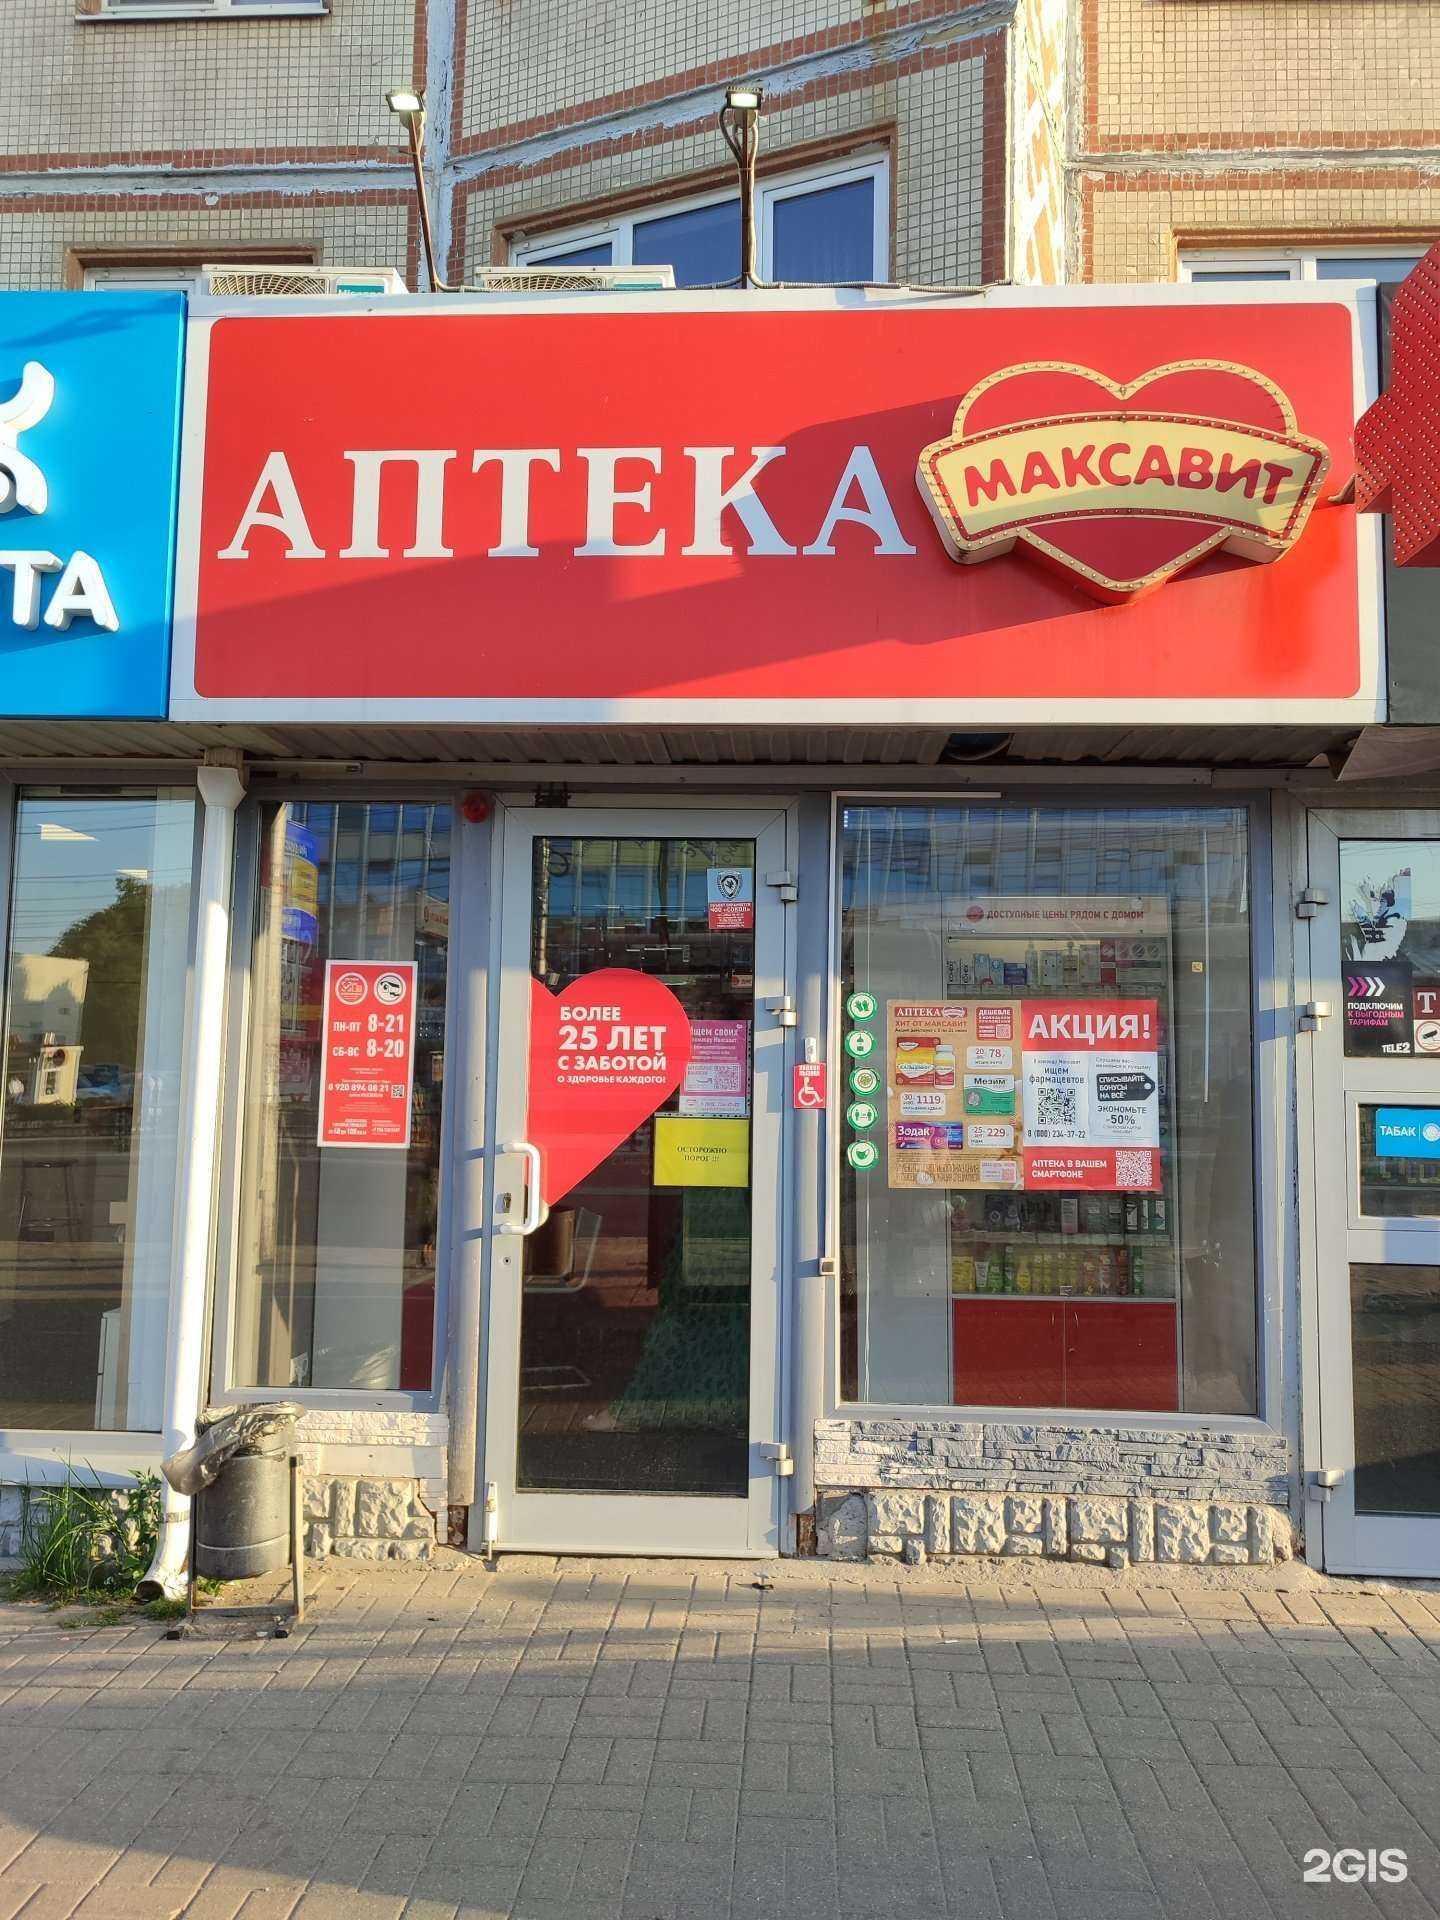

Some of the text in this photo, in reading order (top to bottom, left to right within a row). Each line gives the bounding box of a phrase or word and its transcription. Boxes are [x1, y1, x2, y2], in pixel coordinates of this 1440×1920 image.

[963, 442, 1294, 507] МАКСАВИТ
[217, 445, 917, 560] АПТЕКА
[987, 910, 1144, 920] ДОСТУПНЫЕ ЦЕНЫ РЯДОМ С ДОМОМ
[1347, 1002, 1404, 1011] ПОДКЛЮЧИМ
[560, 1006, 621, 1021] БОЛЕЕ
[897, 1007, 941, 1017] АПТЕКА
[1355, 1010, 1404, 1019] ВЫГОДНЫМ
[333, 1013, 404, 1033] ПН-ПТ 8-21
[1348, 1018, 1388, 1026] ТАРИФАМ
[1028, 1014, 1150, 1045] АКЦИЯ!
[558, 1025, 667, 1051] 25 ЛЕТ
[332, 1038, 404, 1058] СБ-ВС 8-20
[989, 1048, 1001, 1058] 78
[1382, 1042, 1411, 1054] TELE2
[557, 1055, 569, 1071] С
[573, 1052, 667, 1071] ЗАБОТОЙ
[1044, 1067, 1069, 1075] ищем
[557, 1076, 565, 1084] О
[566, 1075, 615, 1085] ЗДОРОВЬЕ
[974, 1077, 1006, 1085] Мезим
[1029, 1074, 1085, 1085] фармацевтов
[1098, 1074, 1145, 1083] СПИСЫВАЙТЕ
[1099, 1083, 1128, 1091] БОНУСЫ
[916, 1095, 941, 1105] 1119
[1097, 1105, 1147, 1114] ЭКОНОМЬТЕ
[1106, 1114, 1136, 1125] -50%
[897, 1125, 930, 1137] Зодак
[987, 1128, 1006, 1137] 229
[1027, 1129, 1032, 1137] 8
[1380, 1125, 1416, 1137] ТАБАК
[677, 1146, 727, 1154] ОСТОРОЖНО
[684, 1153, 709, 1162] ПОРОГ
[1031, 1160, 1107, 1168] АПТЕКА В ВАШЕМ
[1031, 1169, 1084, 1178] СМАРТФОНЕ
